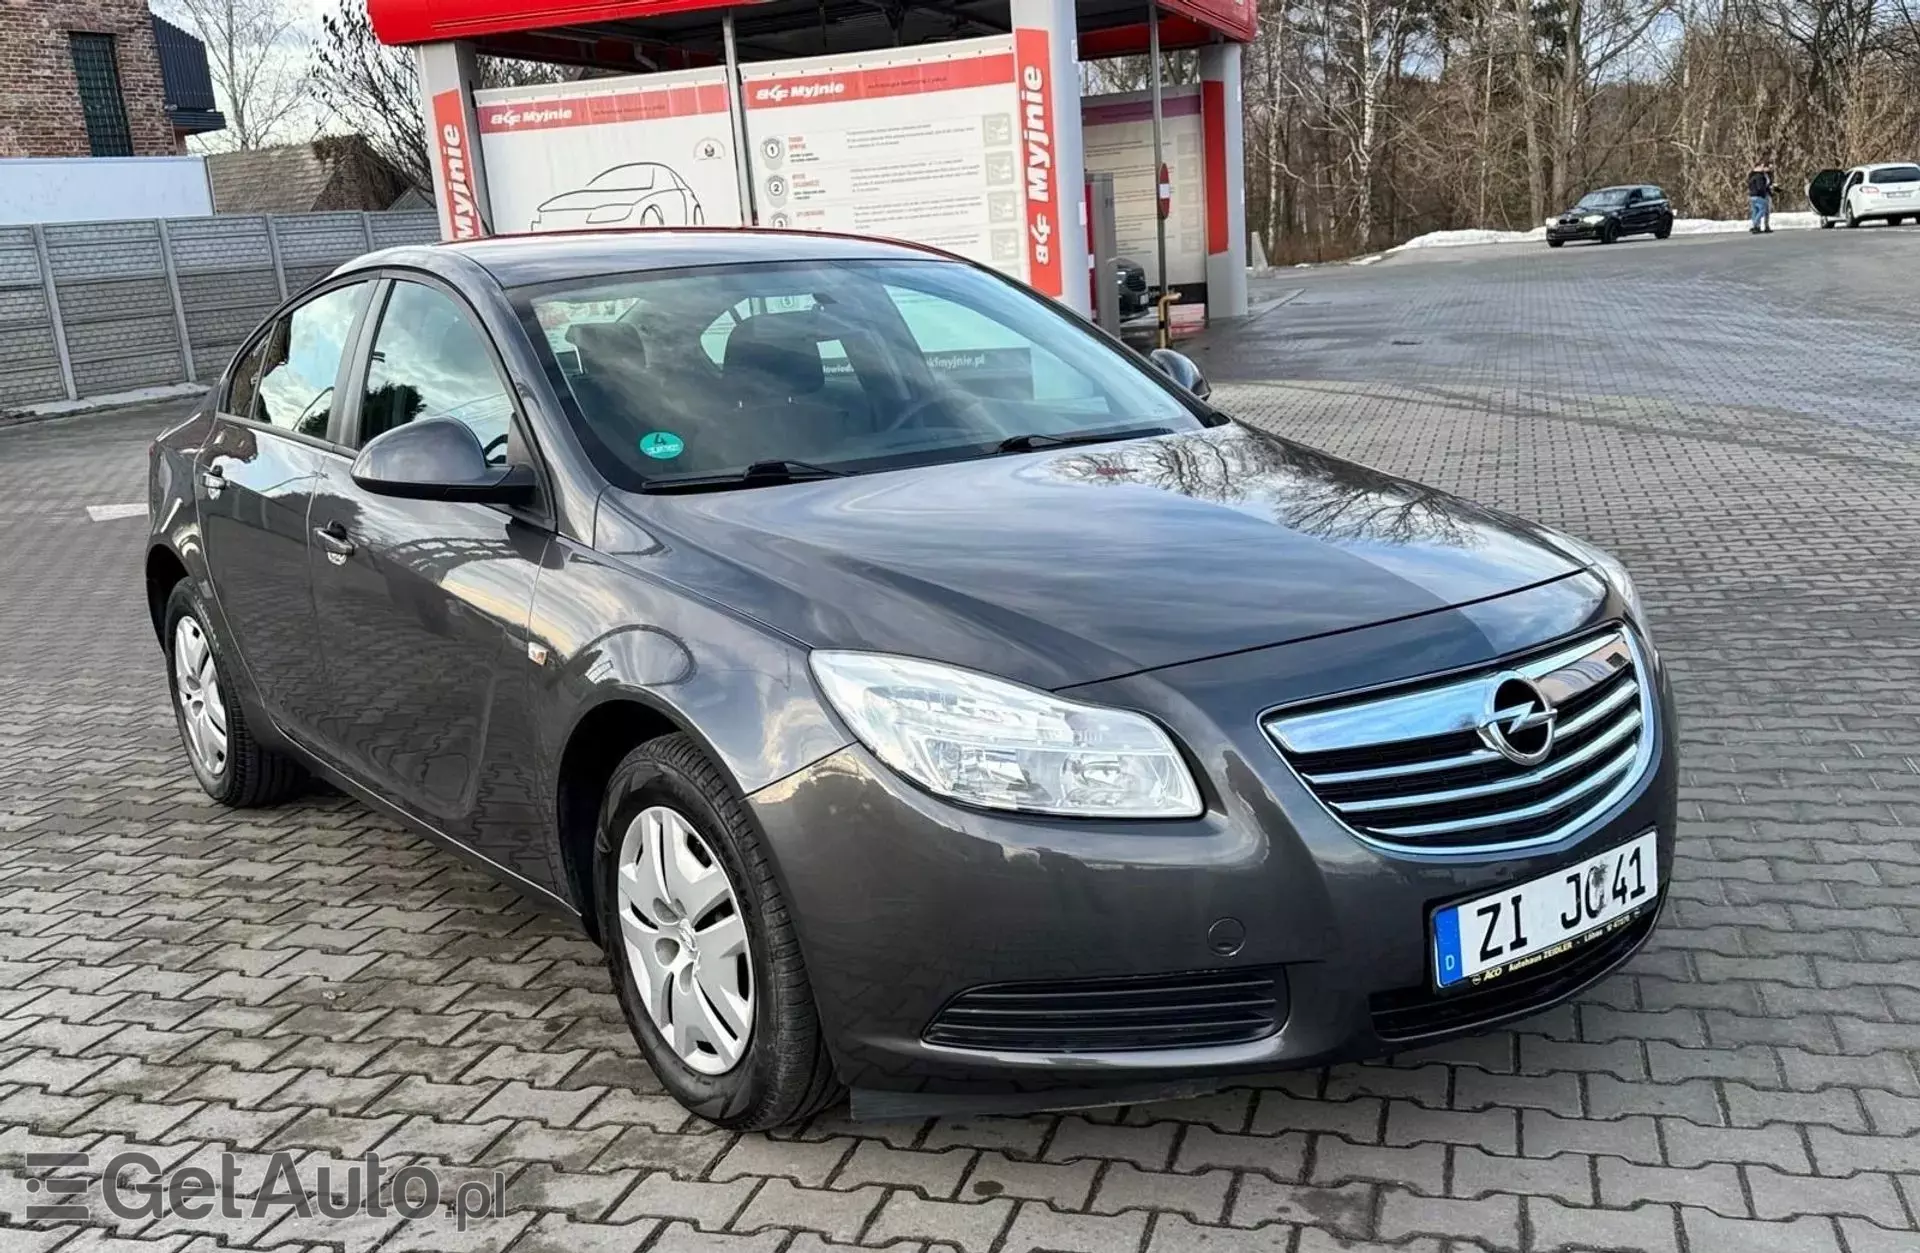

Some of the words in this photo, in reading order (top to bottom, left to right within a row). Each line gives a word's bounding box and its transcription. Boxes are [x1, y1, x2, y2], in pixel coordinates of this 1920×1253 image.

[791, 81, 845, 97] Myjnie
[522, 108, 572, 123] Myjnie
[1021, 65, 1050, 202] Myjnie
[654, 433, 667, 445] 4
[1477, 894, 1528, 962] ZI
[1445, 954, 1455, 971] D
[1508, 954, 1542, 972] Autohaus
